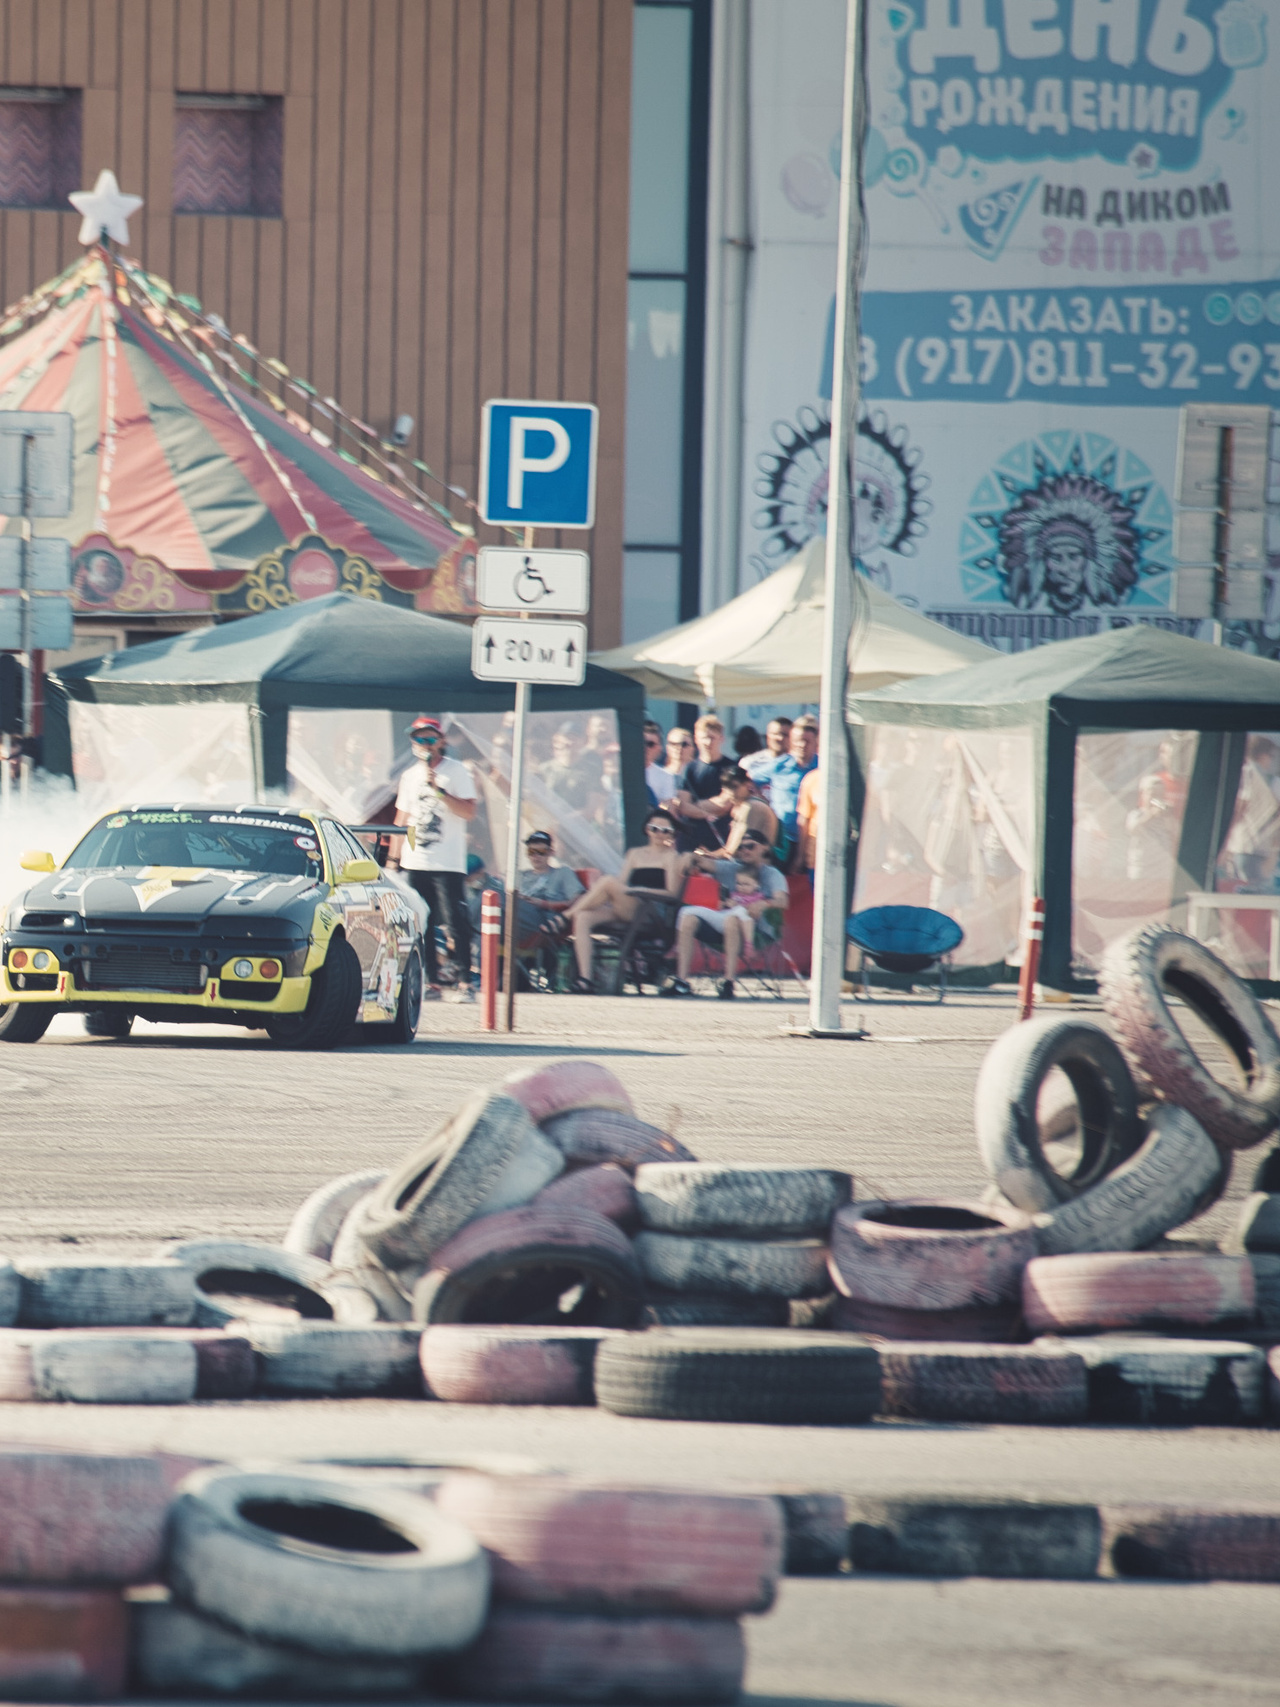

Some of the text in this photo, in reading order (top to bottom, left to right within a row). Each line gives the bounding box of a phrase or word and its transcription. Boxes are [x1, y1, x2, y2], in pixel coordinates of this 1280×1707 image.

[908, 0, 1214, 76] ДЕНЬ
[908, 76, 1201, 137] РОЖДЕНИЯ
[1042, 181, 1232, 229] НА ДИКОМ
[1038, 218, 1241, 277] ЗАПАДЕ
[948, 294, 1191, 336] ЗАКАЗАТЬ:
[507, 415, 571, 510] P
[505, 639, 533, 662] 20
